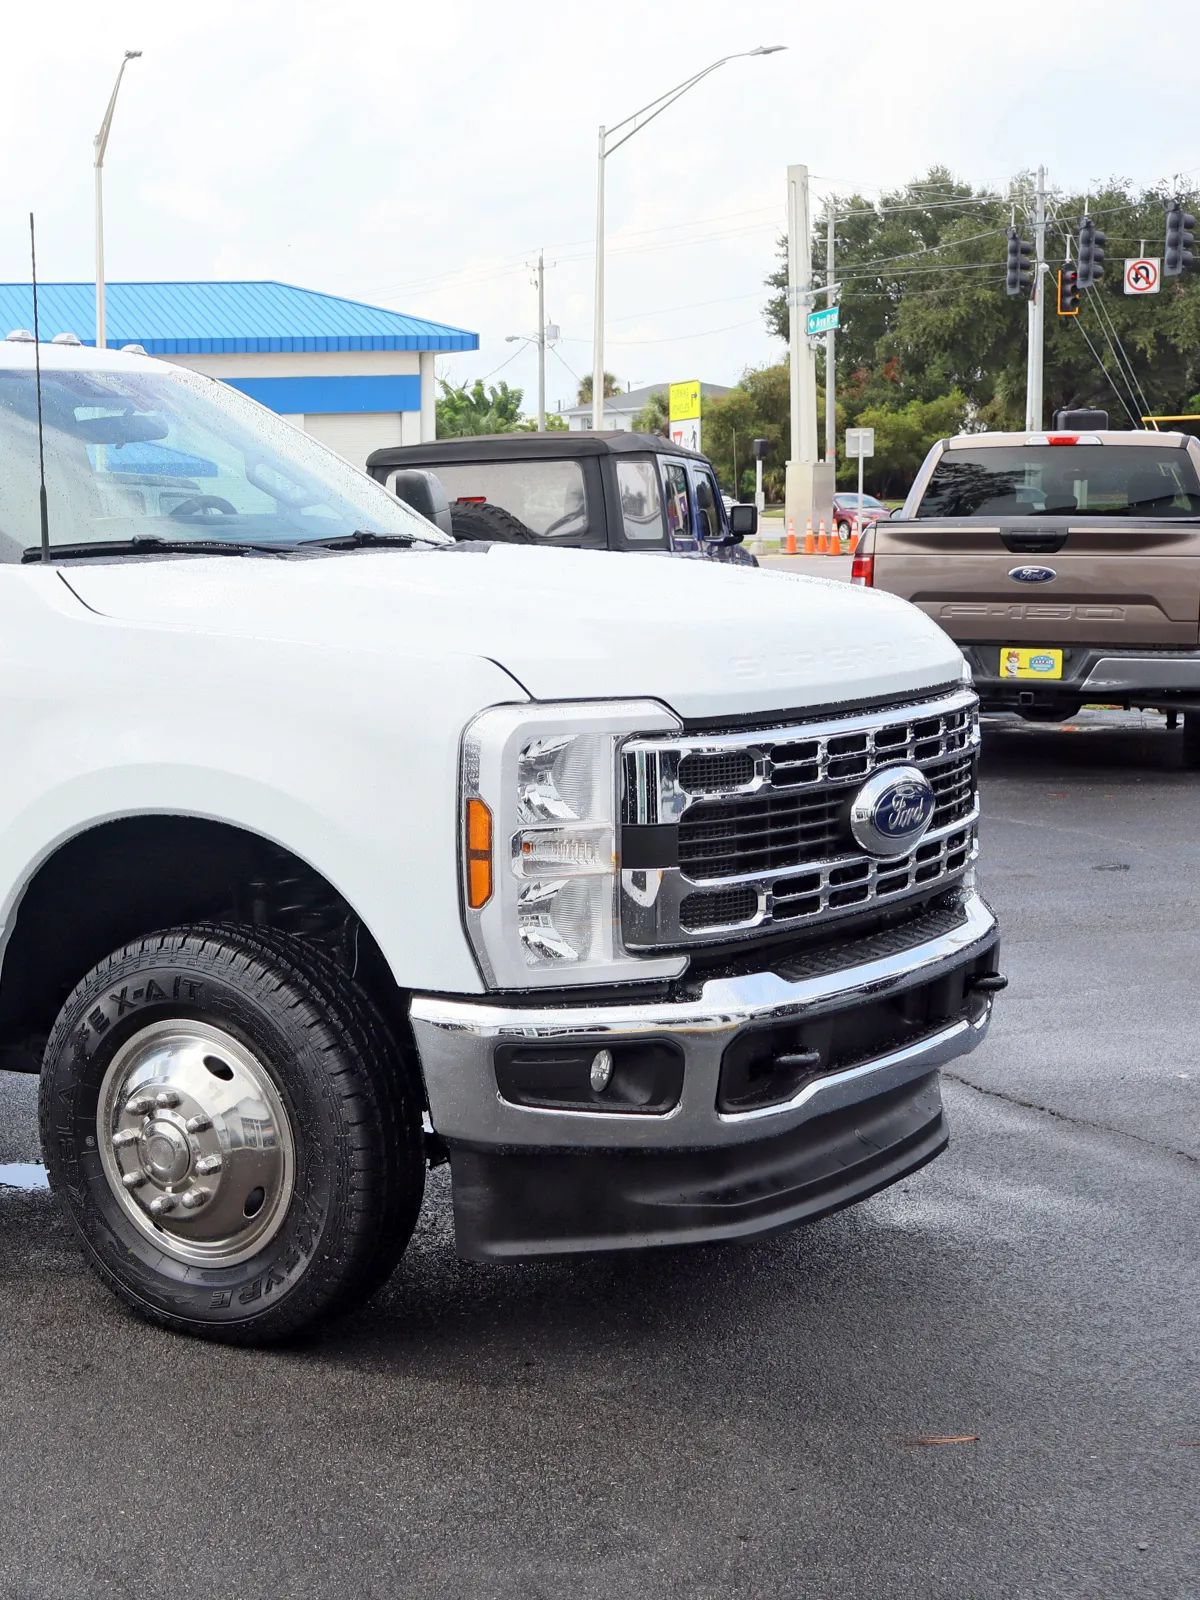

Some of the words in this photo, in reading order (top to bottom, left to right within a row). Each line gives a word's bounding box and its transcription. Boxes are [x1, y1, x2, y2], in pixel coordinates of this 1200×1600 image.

[1019, 568, 1047, 581] Ford
[939, 603, 1126, 621] F-150
[888, 786, 924, 830] Ford
